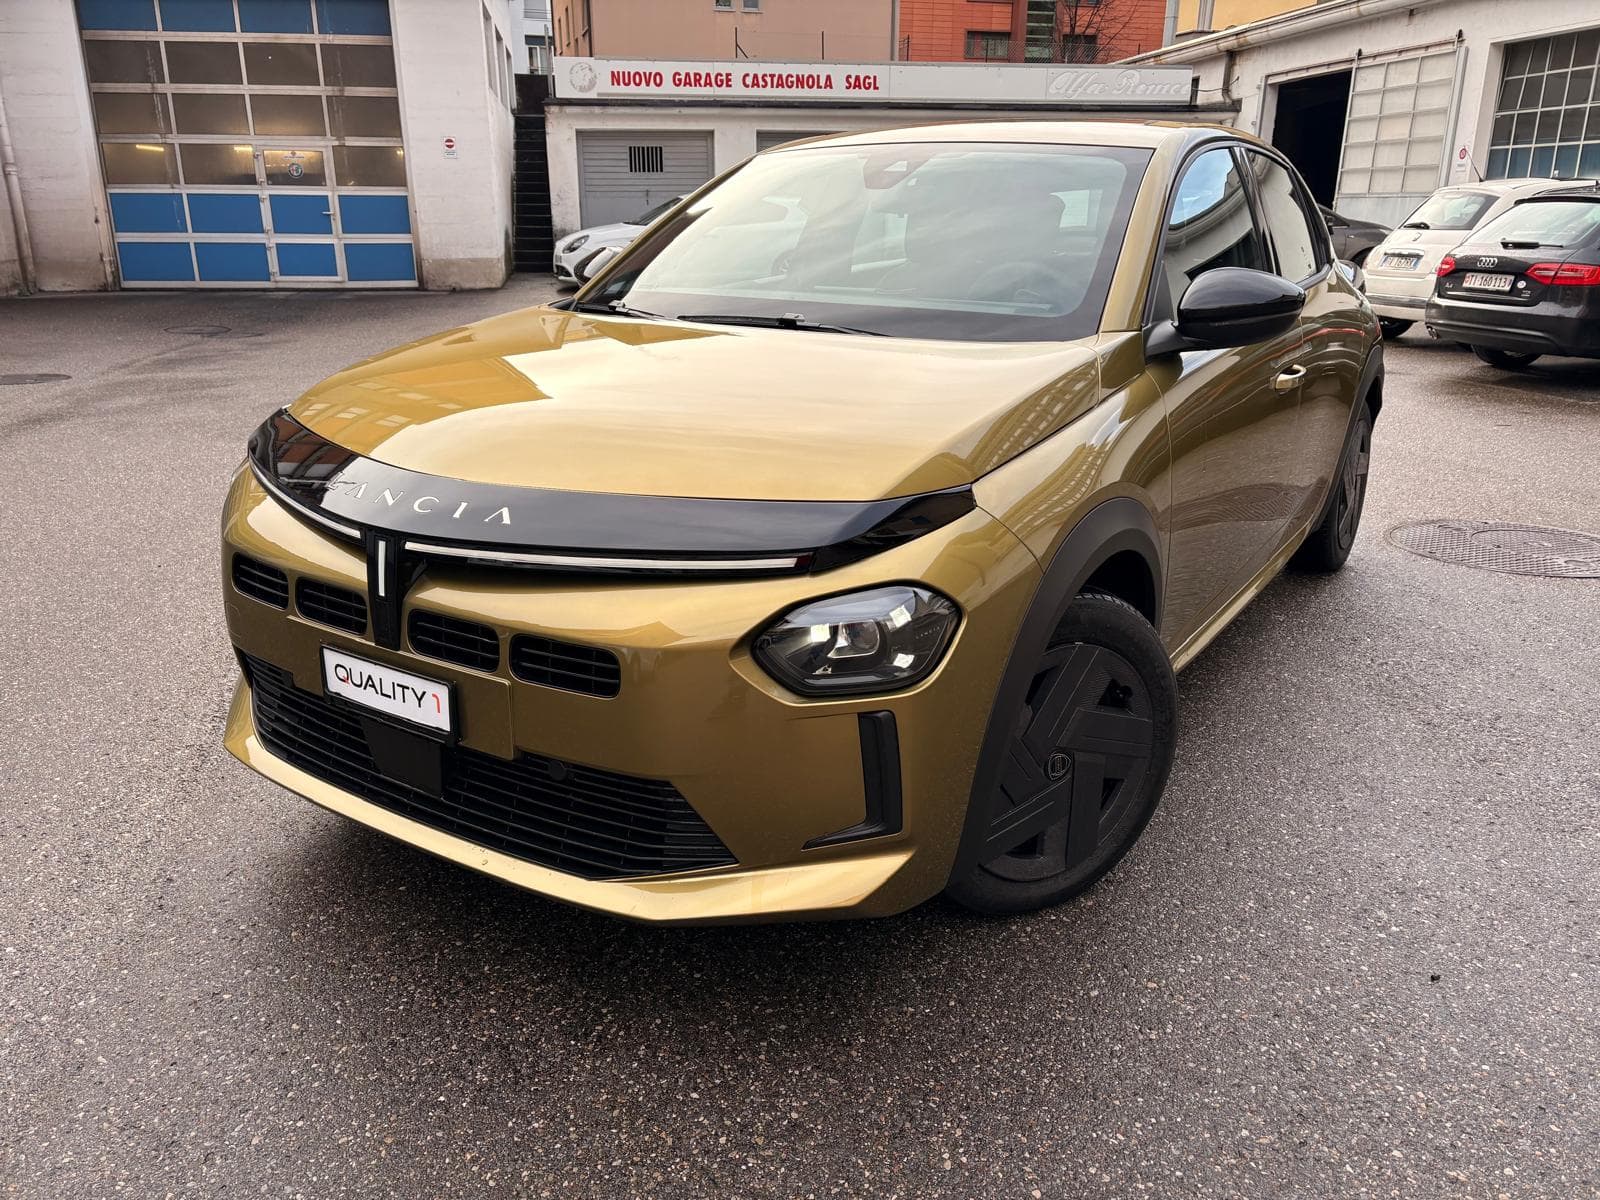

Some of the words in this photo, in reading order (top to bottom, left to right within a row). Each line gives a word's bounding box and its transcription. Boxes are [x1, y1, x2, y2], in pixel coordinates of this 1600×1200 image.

[609, 70, 664, 88] NUOVO
[671, 71, 733, 89] GARAGE
[741, 72, 834, 91] CASTAGNOLA
[844, 74, 880, 92] SAGL
[1049, 70, 1109, 99] Alfa
[334, 663, 427, 709] QUALITY
[431, 692, 441, 714] 1
